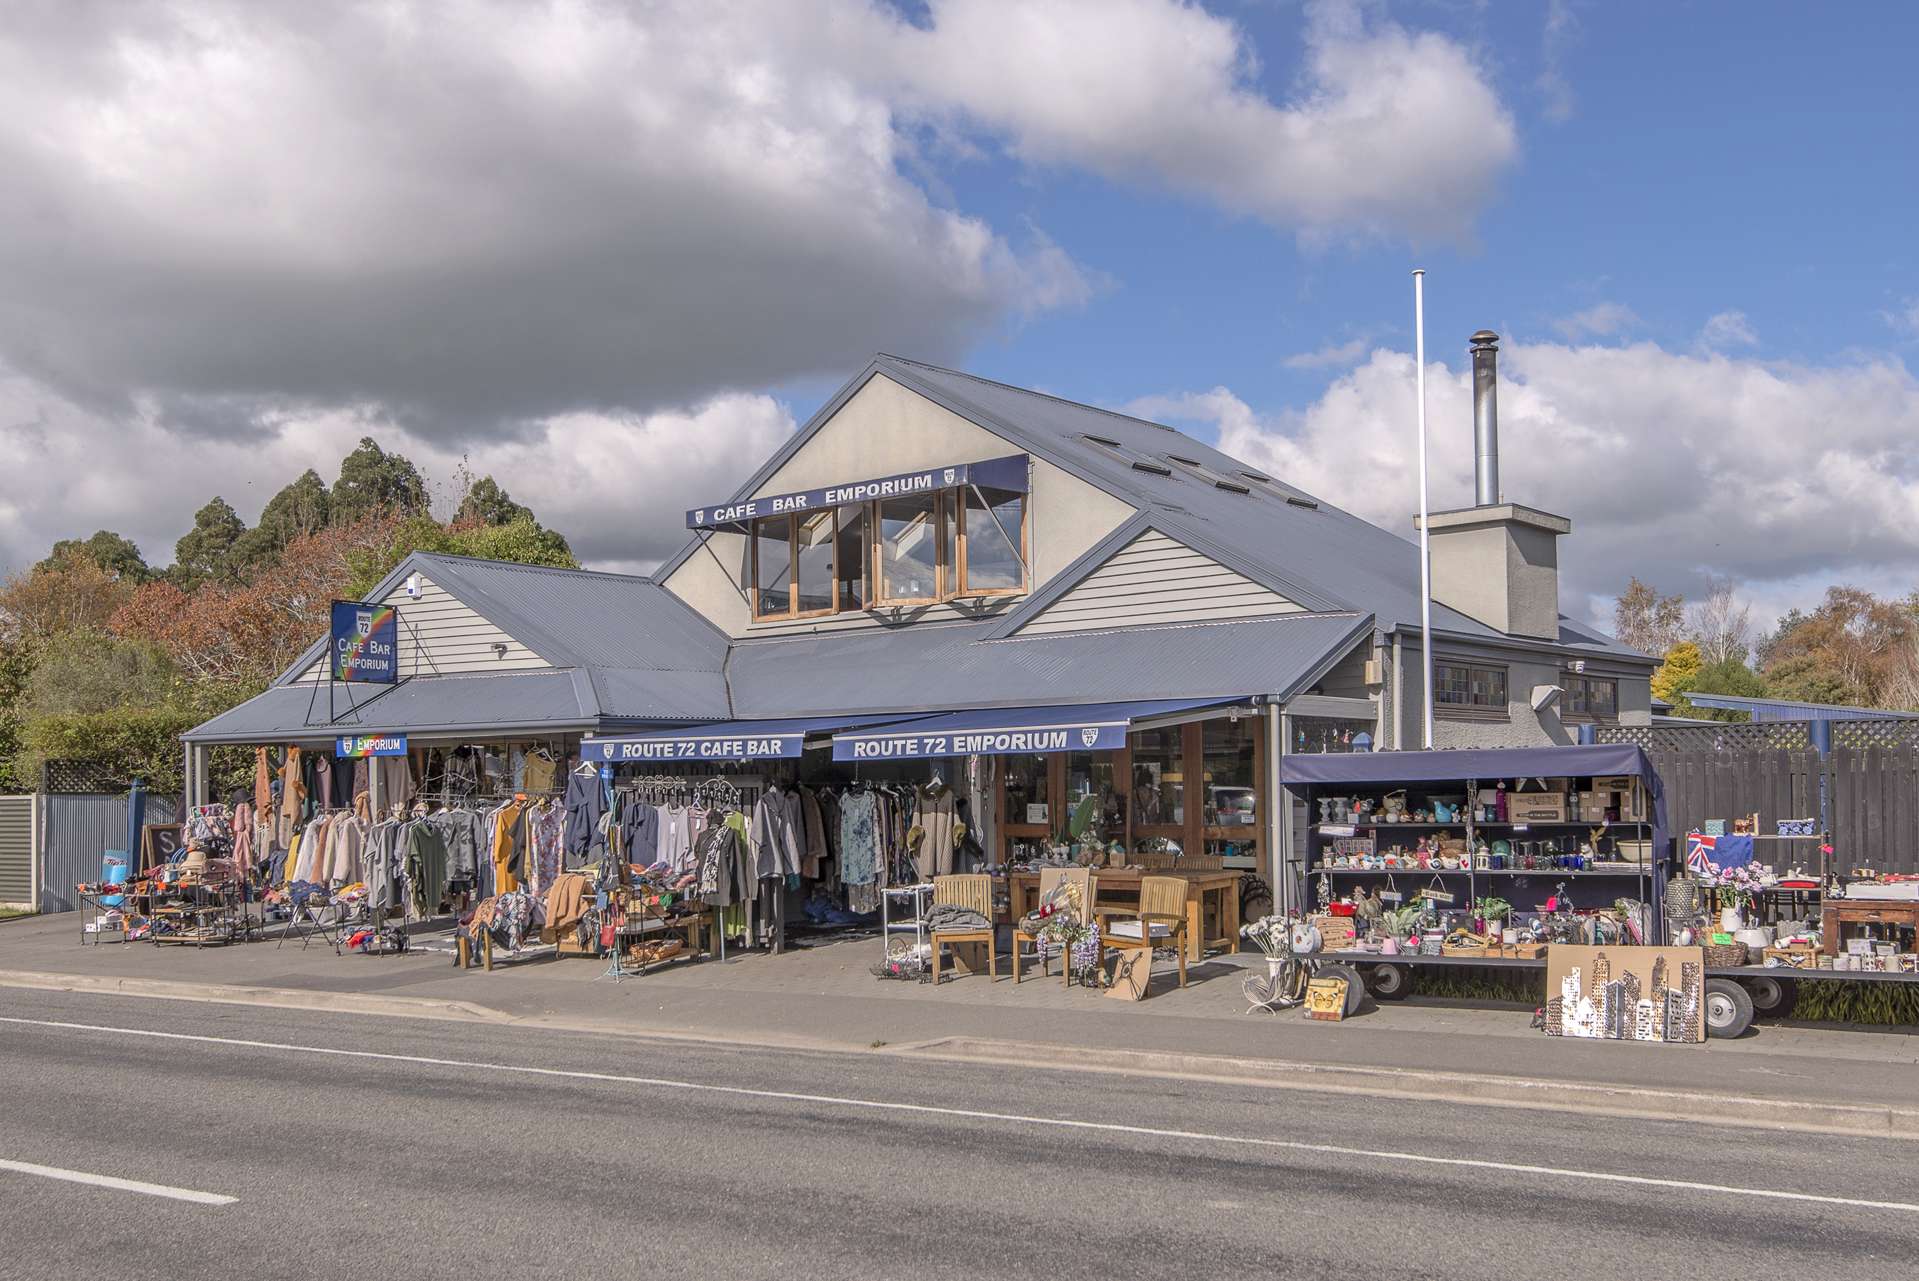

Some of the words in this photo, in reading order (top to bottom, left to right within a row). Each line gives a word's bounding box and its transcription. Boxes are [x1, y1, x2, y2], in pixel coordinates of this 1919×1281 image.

[713, 503, 756, 521] CAFE
[772, 495, 807, 511] BAR
[825, 474, 932, 504] EMPORIUM
[359, 622, 369, 633] 72
[622, 743, 674, 758] ROUTE
[677, 742, 695, 757] 72
[701, 741, 743, 756] CAFE
[747, 739, 782, 755] BAR
[854, 740, 918, 757] ROUTE
[923, 738, 946, 754] 72
[953, 731, 1067, 753] EMPORIUM
